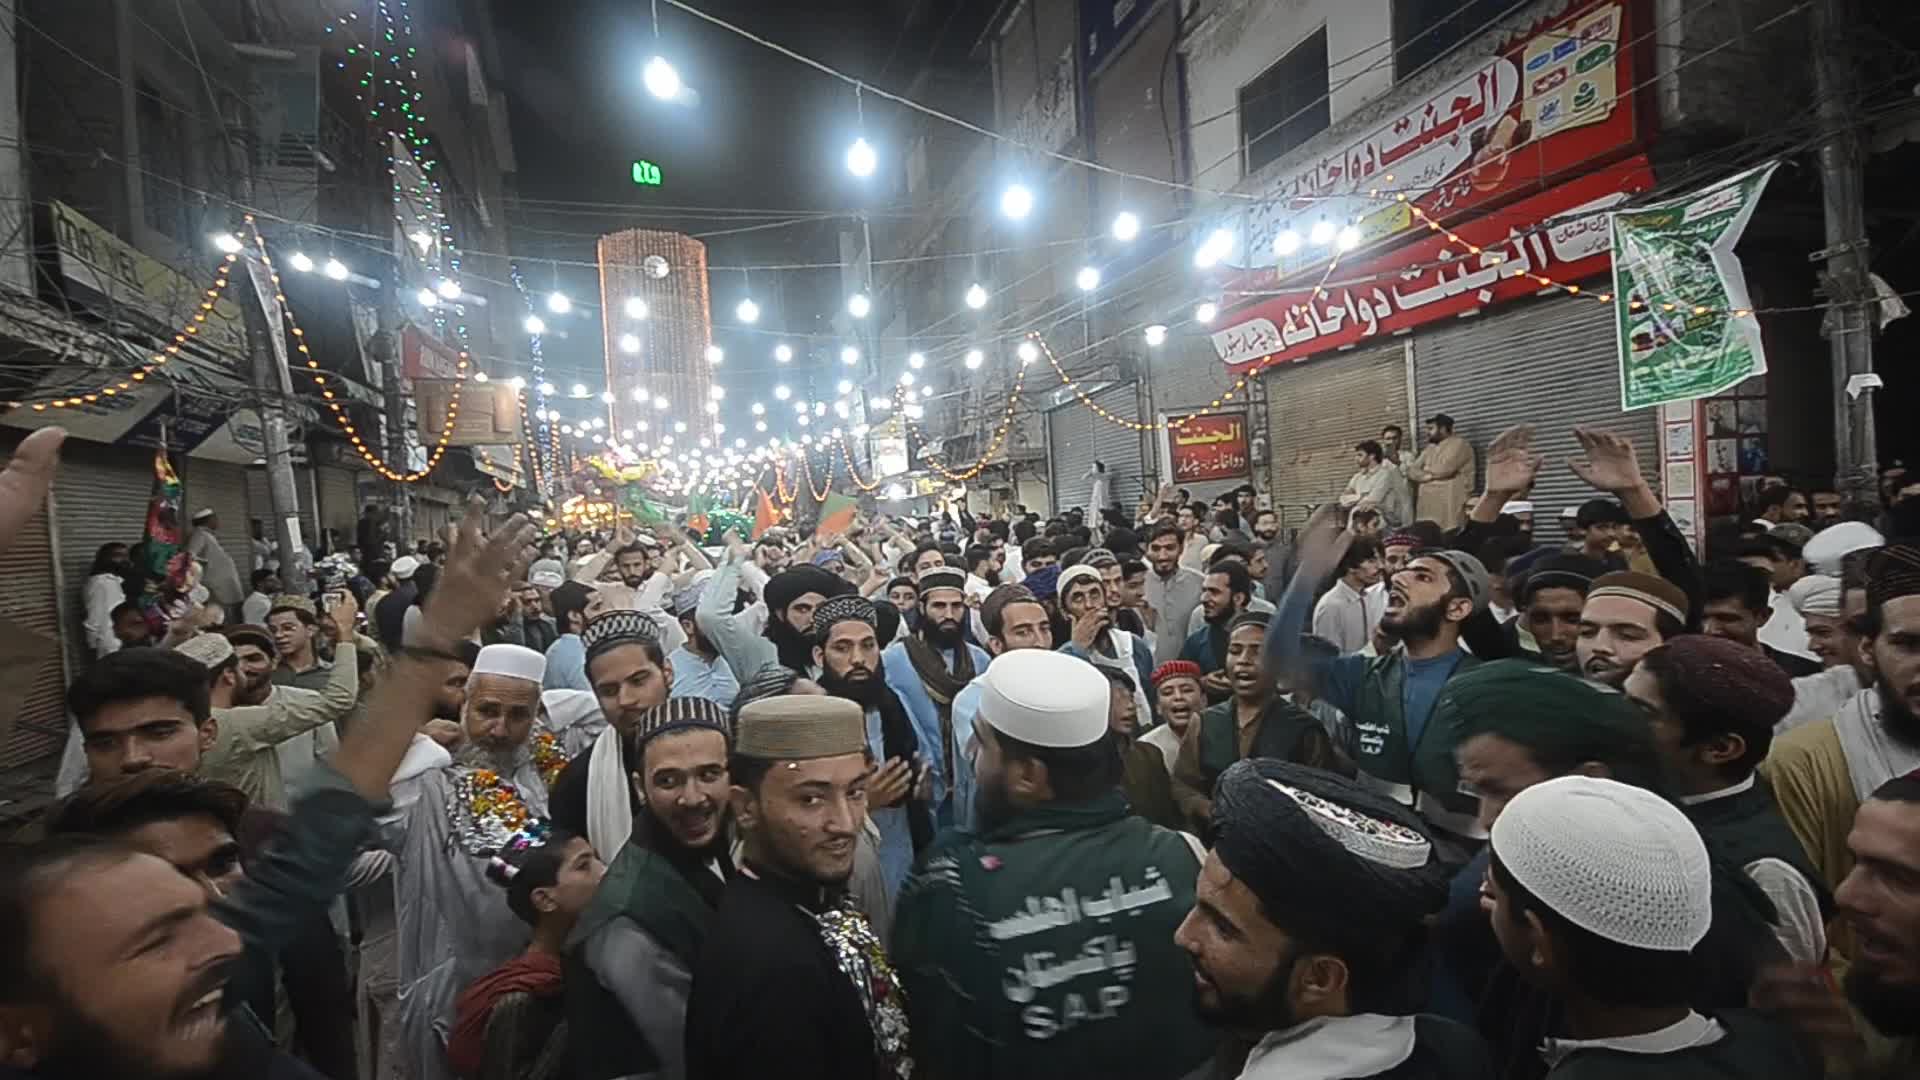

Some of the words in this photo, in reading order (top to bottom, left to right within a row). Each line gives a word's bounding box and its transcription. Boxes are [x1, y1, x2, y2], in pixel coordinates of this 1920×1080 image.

[1379, 61, 1497, 166] الجنت
[1391, 224, 1548, 311] الجنت
[1282, 286, 1393, 347] دواخانہ
[1175, 421, 1241, 451] الجنت
[1212, 451, 1245, 471] دواخانہ
[1081, 865, 1173, 924] شباب
[1002, 935, 1137, 1003] پاکستان
